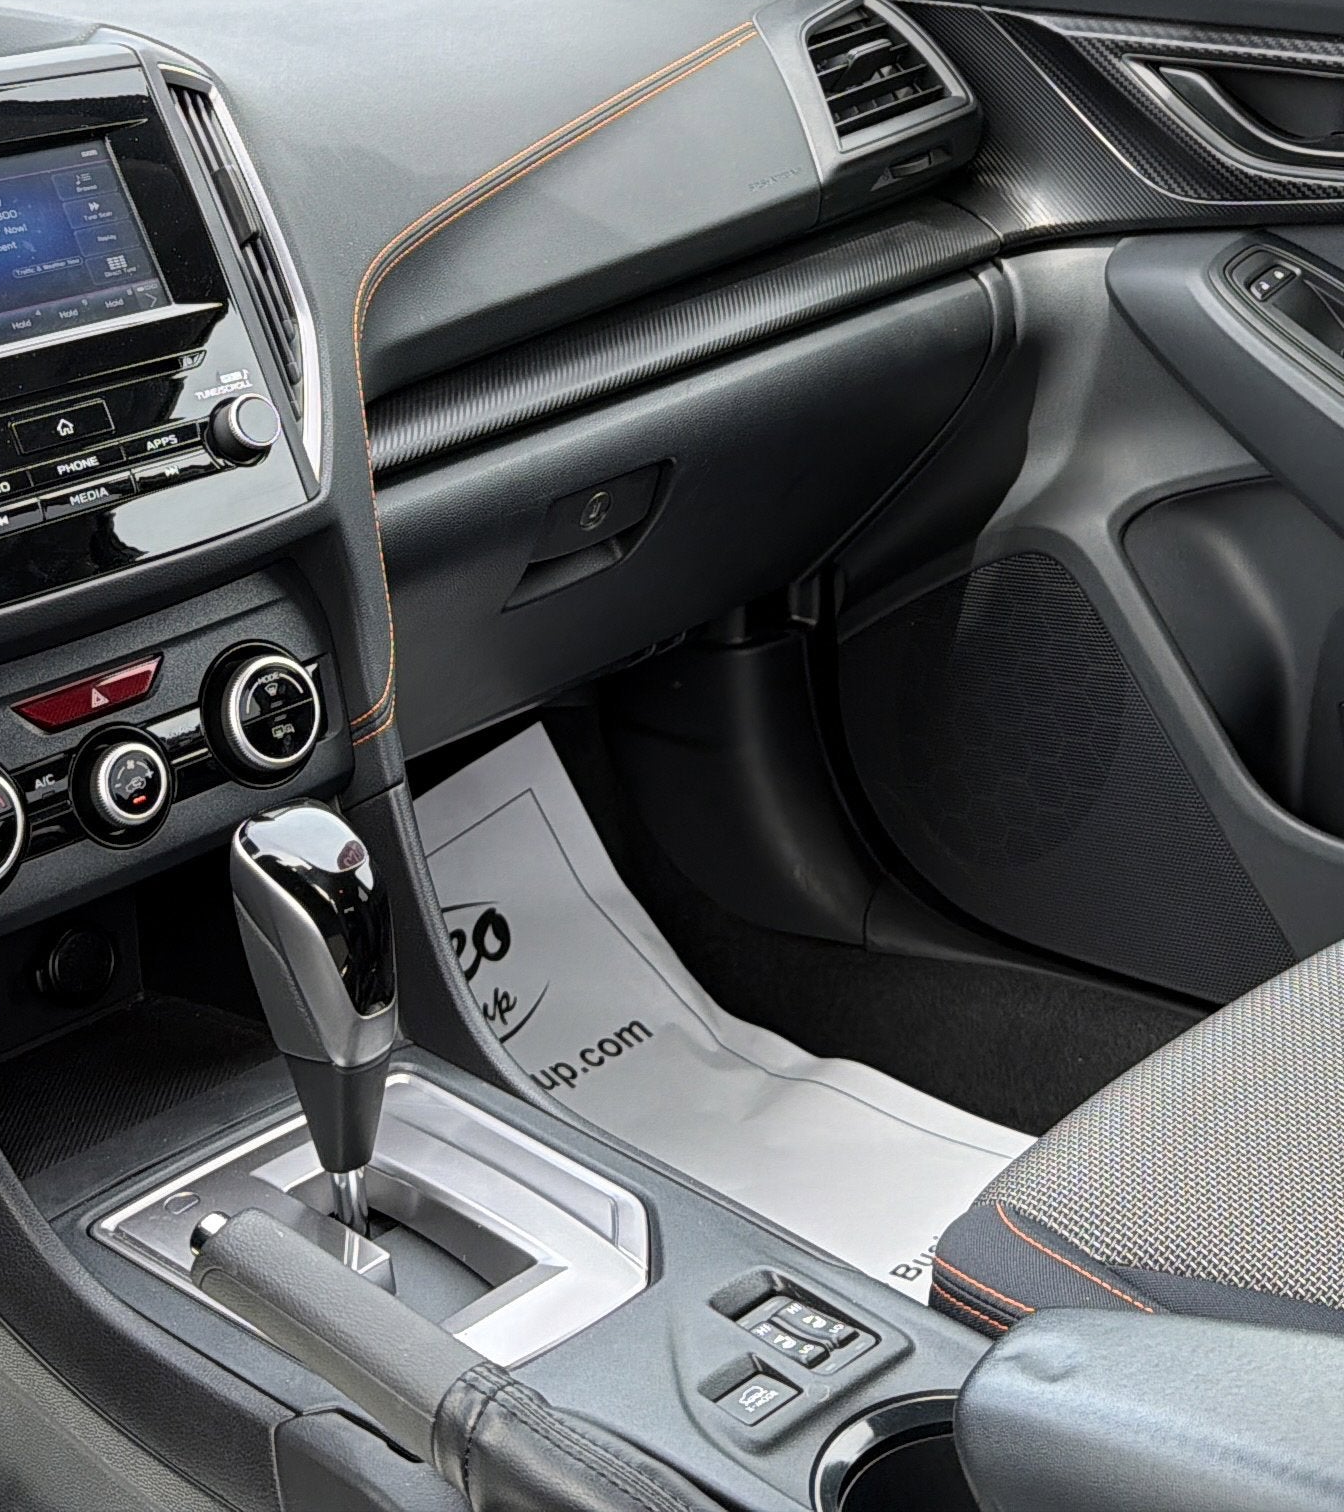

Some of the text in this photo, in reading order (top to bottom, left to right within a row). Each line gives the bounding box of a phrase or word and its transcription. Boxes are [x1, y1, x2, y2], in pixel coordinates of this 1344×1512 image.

[4, 223, 28, 236] Now!
[105, 298, 125, 309] Hold
[58, 308, 79, 320] Hold
[11, 319, 32, 331] Hold
[145, 433, 179, 452] APPS
[56, 455, 100, 476] PHONE
[69, 487, 110, 506] MEDIA
[257, 671, 281, 686] MODE
[34, 772, 55, 790] A/C
[531, 1018, 654, 1094] up.com
